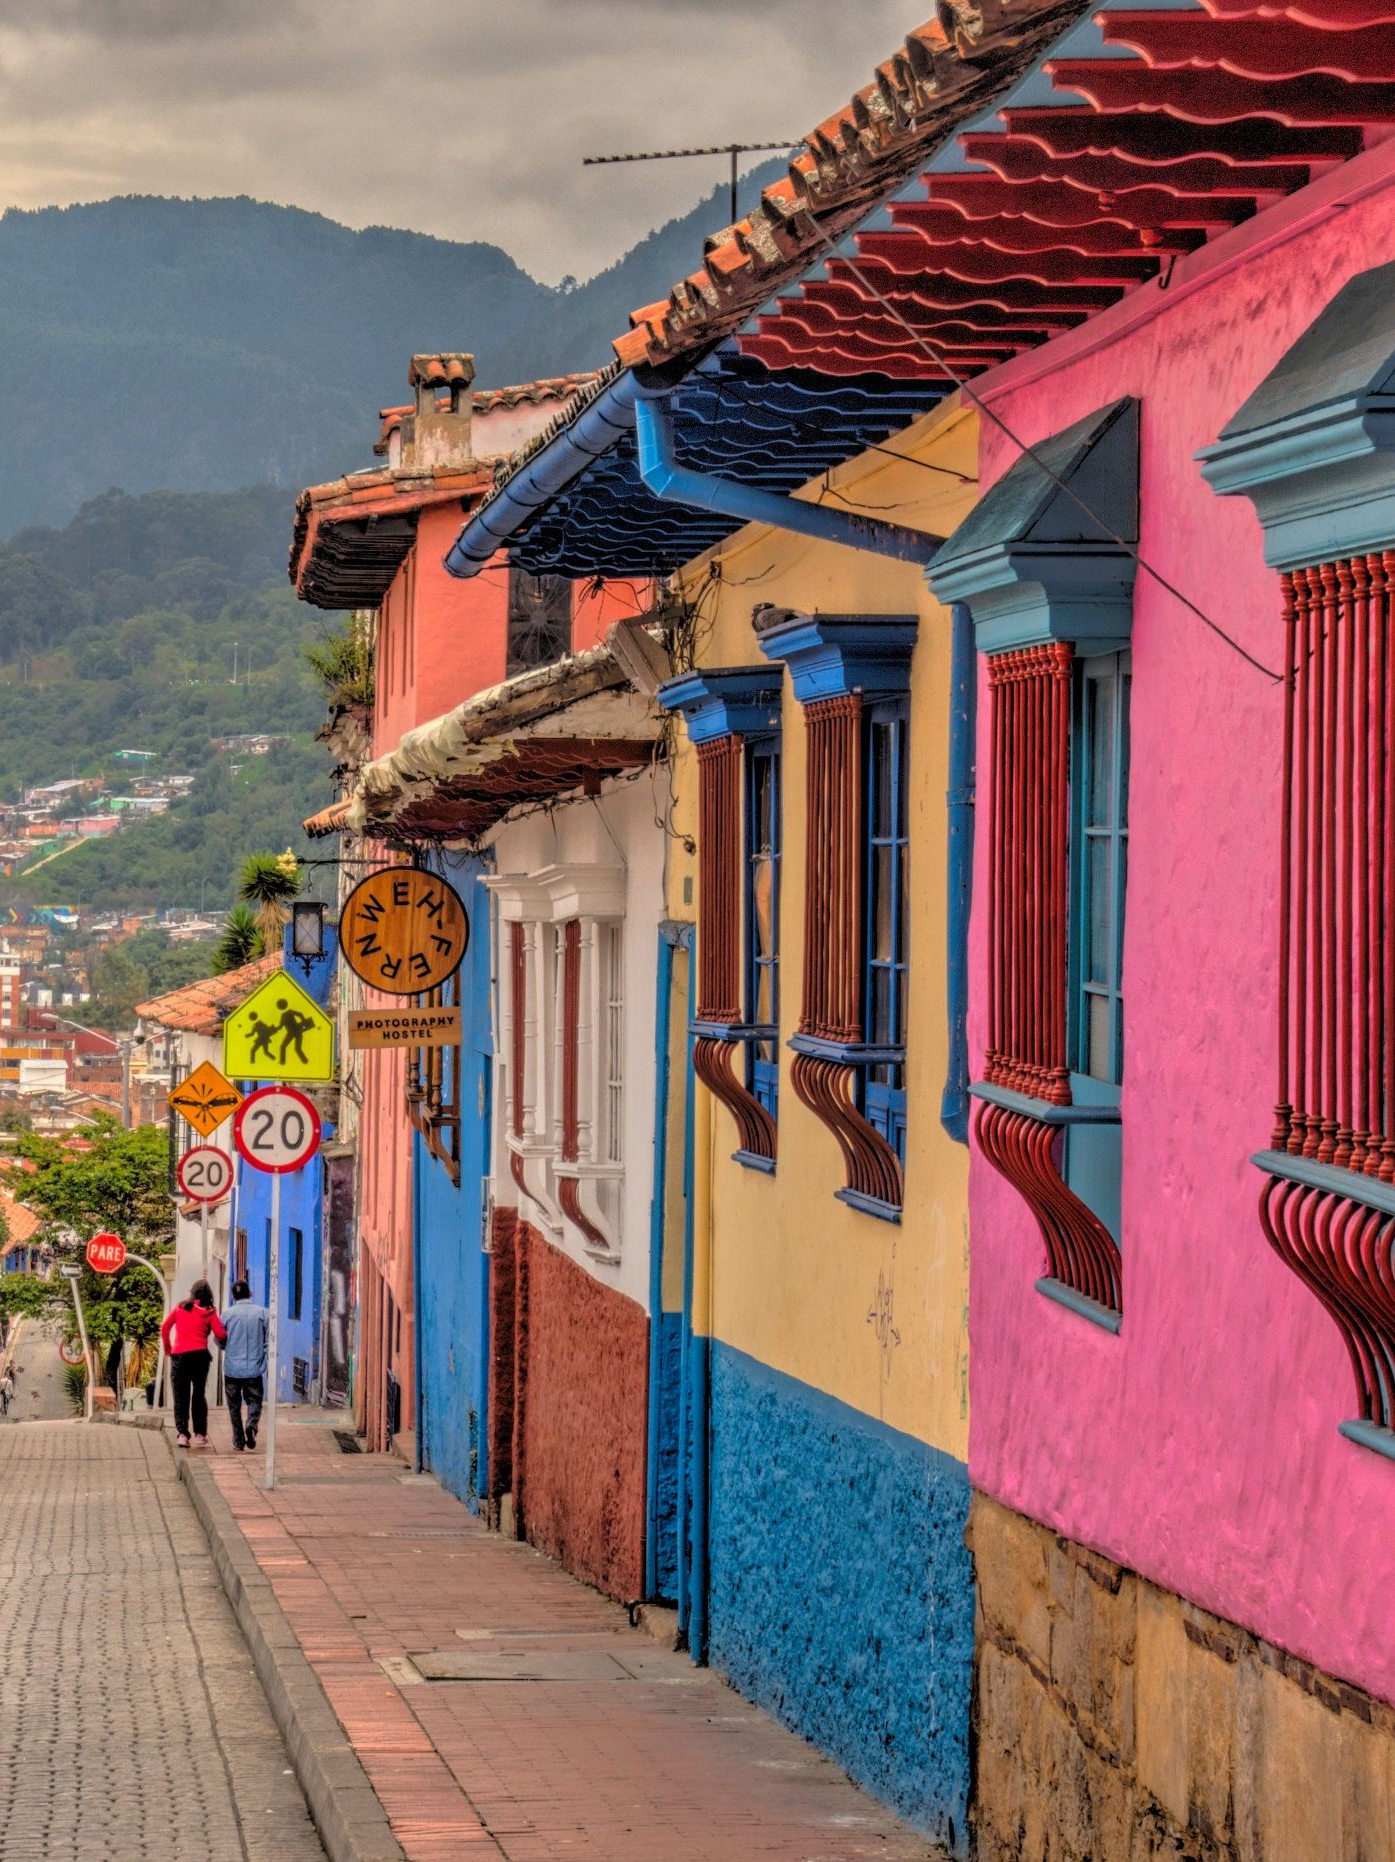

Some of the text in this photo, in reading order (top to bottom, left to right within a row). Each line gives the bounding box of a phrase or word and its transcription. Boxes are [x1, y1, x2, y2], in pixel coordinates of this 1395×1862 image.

[357, 1016, 455, 1029] PHOTOGRAPHY
[382, 1029, 433, 1040] HOSTEL
[251, 1110, 304, 1150] 20
[187, 1161, 223, 1187] 20
[90, 1244, 122, 1261] PARE
